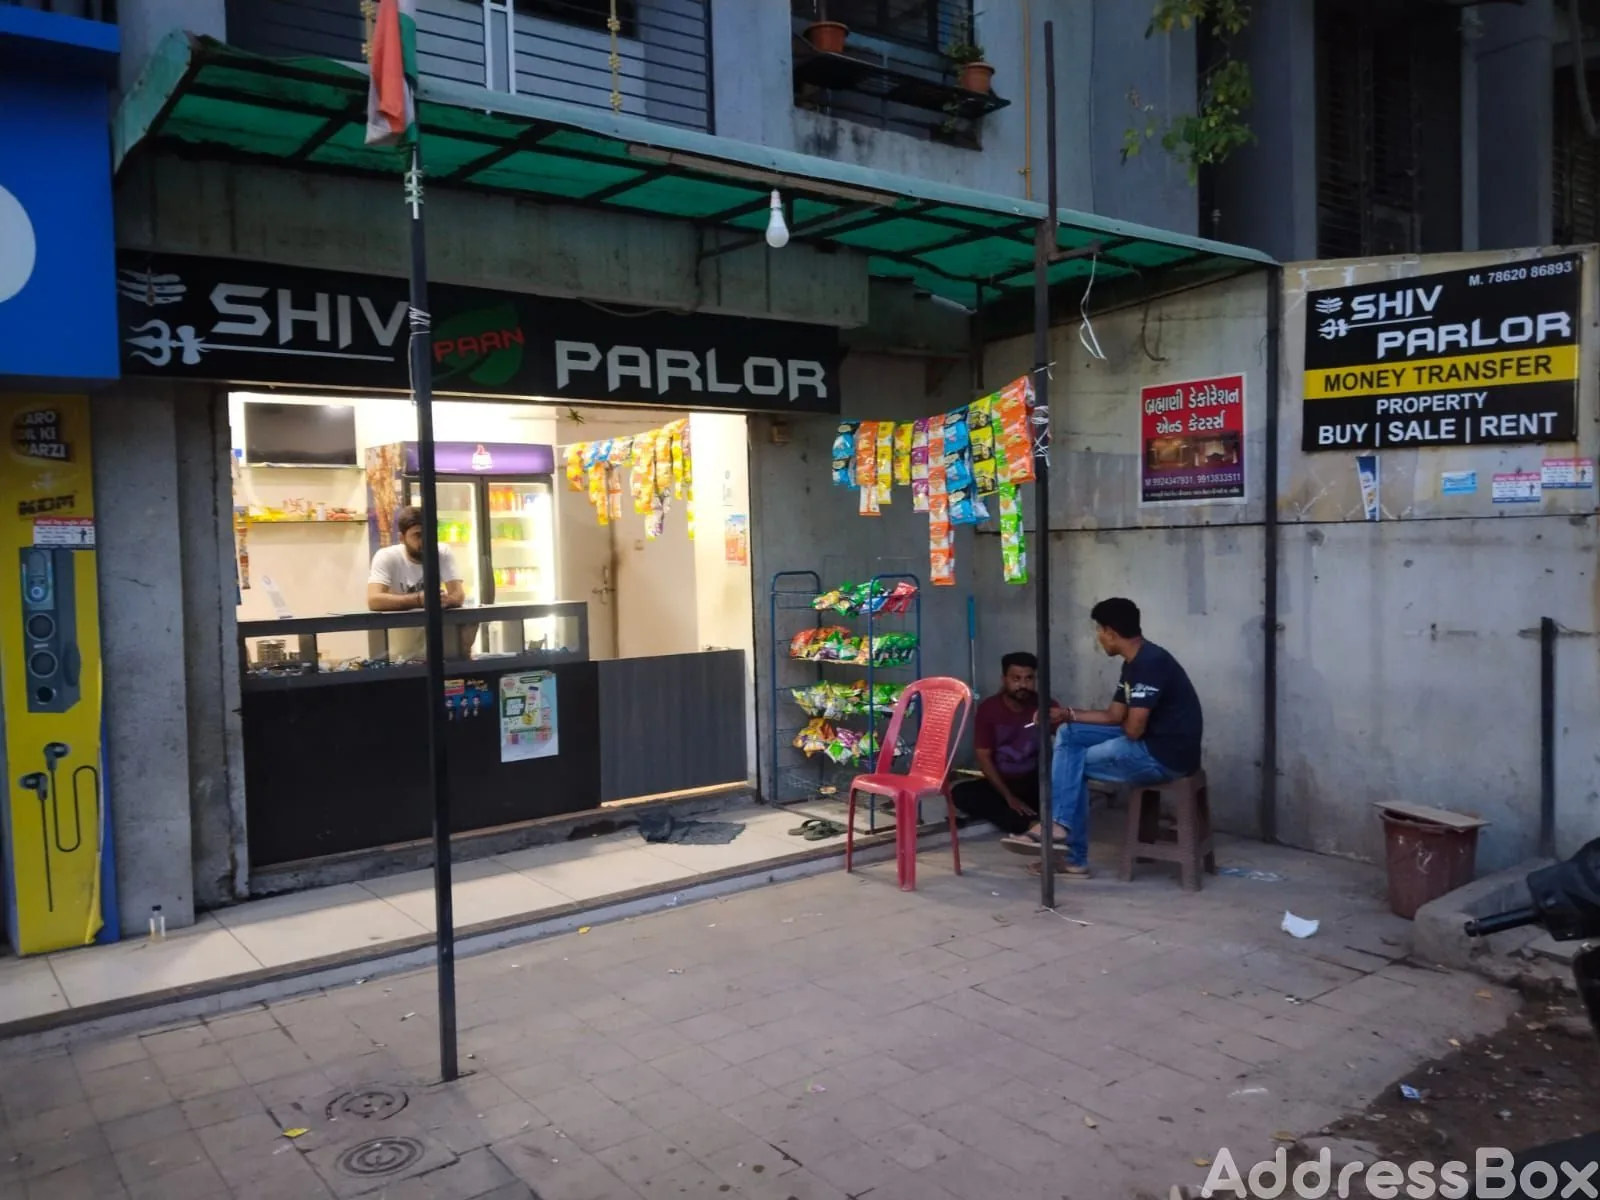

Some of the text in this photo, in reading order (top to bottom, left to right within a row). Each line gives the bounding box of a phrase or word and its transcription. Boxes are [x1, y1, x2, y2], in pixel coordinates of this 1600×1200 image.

[1468, 261, 1573, 287] M. 78620 86893
[1350, 284, 1444, 321] SHIV
[209, 282, 829, 402] SHIV PAAN PARLOR
[1376, 311, 1571, 360] PARLOR
[1323, 355, 1553, 393] MONEY TRANSFER
[1188, 384, 1240, 408] ડેકોરેશન
[1375, 391, 1488, 415] PROPERTY
[23, 410, 57, 425] ARO
[1317, 423, 1368, 446] BUY
[1387, 417, 1457, 443] SALE
[1479, 412, 1559, 438] RENT
[21, 442, 66, 459] ARZI
